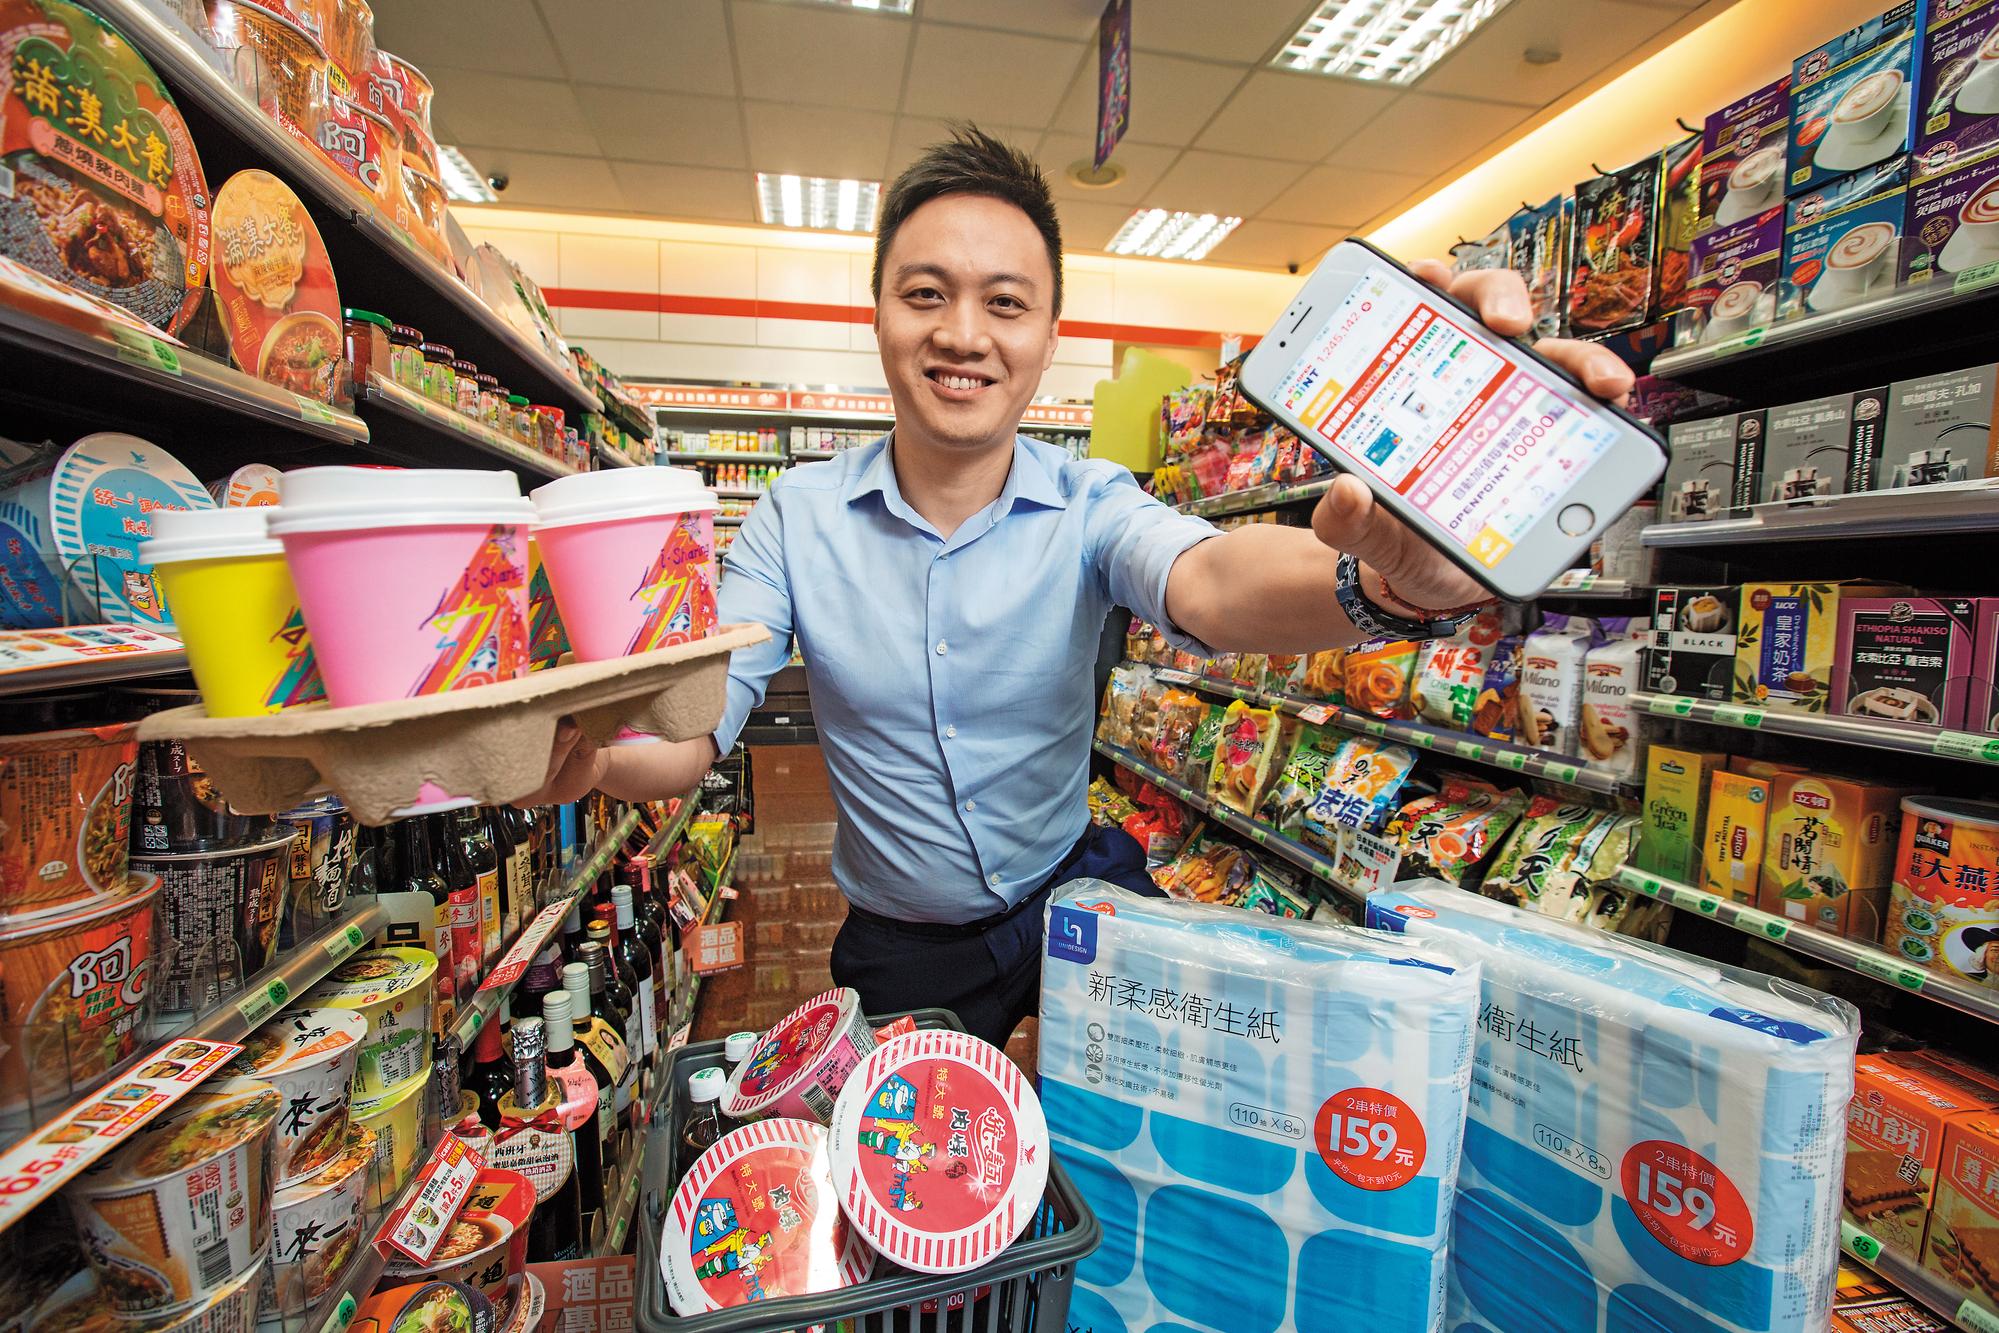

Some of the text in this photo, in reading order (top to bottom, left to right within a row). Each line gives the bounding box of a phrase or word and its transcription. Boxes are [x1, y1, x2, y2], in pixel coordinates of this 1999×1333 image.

[13, 55, 173, 190] 滿漢大餐
[215, 204, 300, 267] 滿漢大餐
[1856, 623, 1948, 636] ETHIOPIA SHAKISO
[1875, 634, 1925, 646] NATURAL
[1360, 640, 1387, 654] Flavor
[1683, 638, 1724, 648] BLACK
[1772, 615, 1793, 683] 皇家奶茶
[1428, 647, 1483, 683] 새우
[1524, 670, 1561, 688] Milano
[1585, 679, 1626, 696] Milano
[1650, 800, 1688, 823] Green
[1795, 792, 1831, 809] 立頓
[1652, 812, 1678, 832] Tea
[1733, 828, 1747, 858] Lipton
[1915, 833, 1950, 850] QUAKER
[701, 927, 736, 946] 酒品
[1058, 941, 1088, 955] UNIDESIGN
[701, 945, 736, 965] 專區
[270, 981, 286, 999] 35
[1087, 970, 1282, 1045] 新柔感衛生紙
[931, 1066, 950, 1121] 特大號
[1346, 1096, 1399, 1119] 2串特價
[948, 1106, 973, 1158] 肉燥
[1329, 1112, 1415, 1168] 159元
[494, 1142, 527, 1158] 西班牙
[976, 1105, 1007, 1187] 統一麵
[1332, 1157, 1403, 1186] 平均一包不到10元
[1654, 1149, 1718, 1189] 2串特價
[739, 1162, 767, 1213] 特大號
[767, 1184, 803, 1234] 肉燥
[1637, 1161, 1738, 1249] 159元
[1852, 1236, 1872, 1253] 35
[562, 1265, 632, 1302] 酒品
[563, 1302, 632, 1333] 專區
